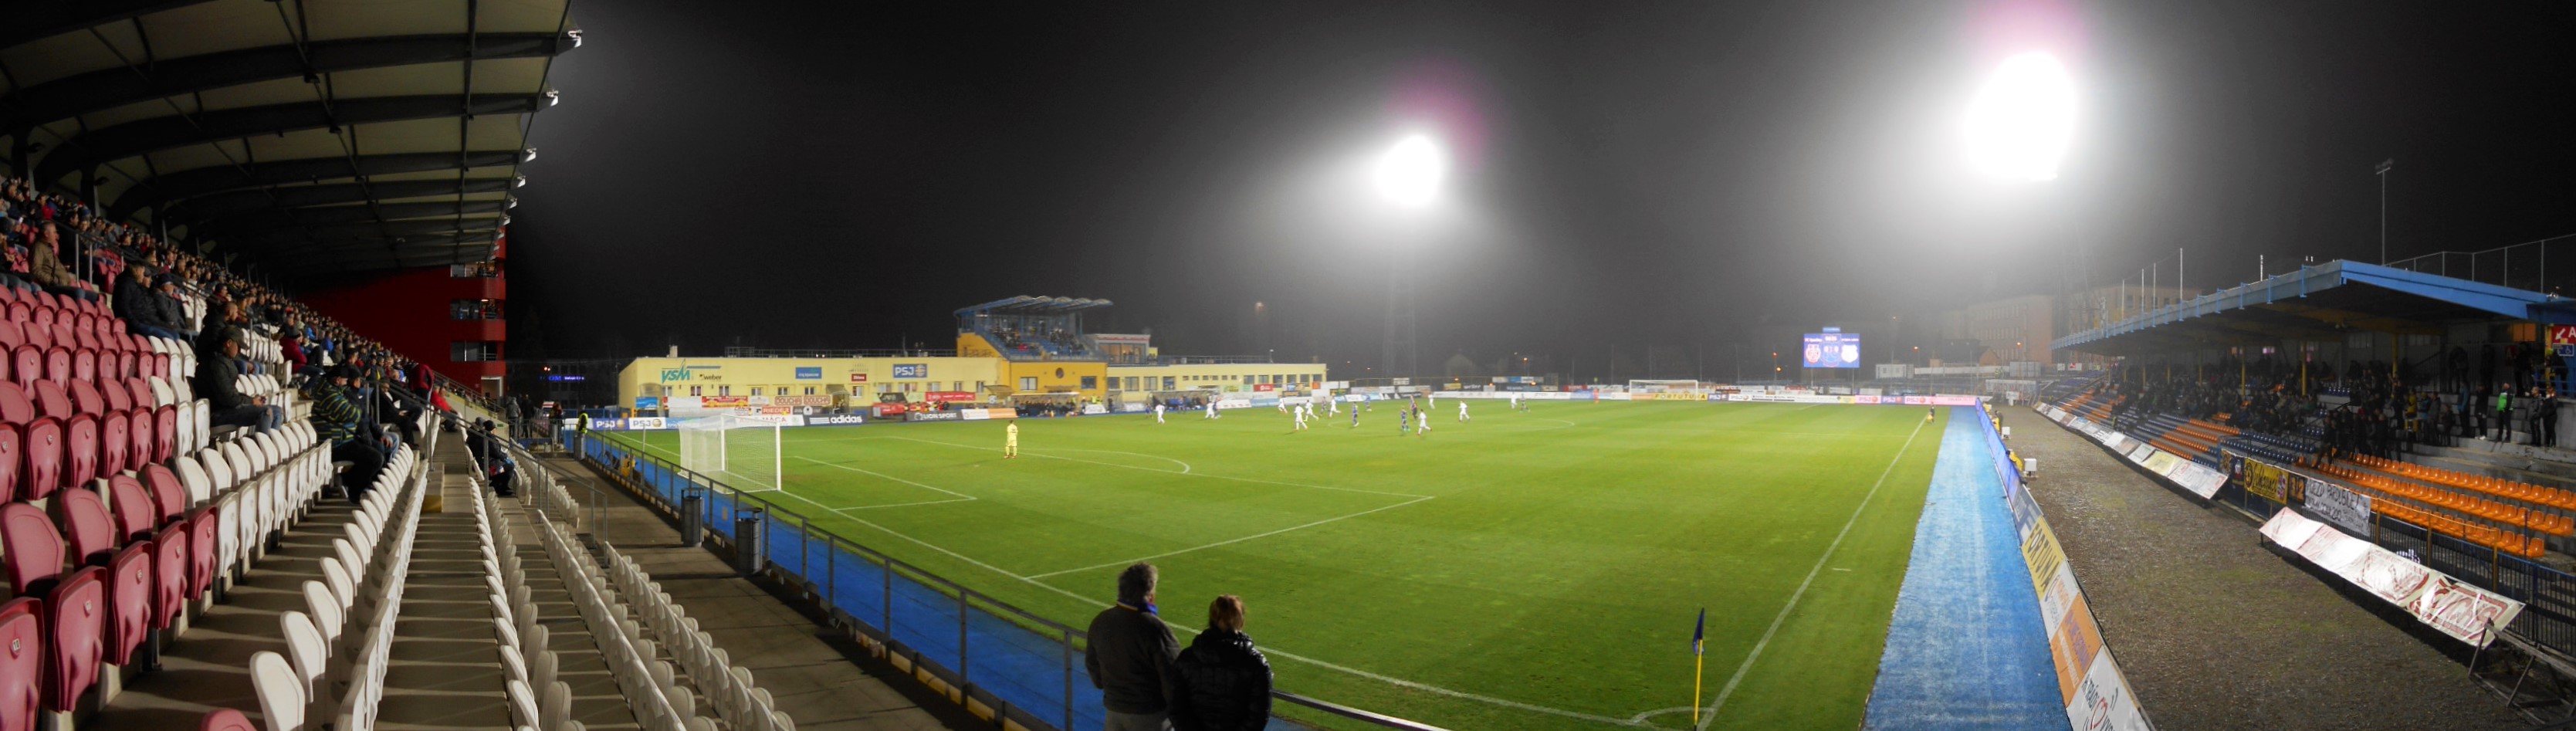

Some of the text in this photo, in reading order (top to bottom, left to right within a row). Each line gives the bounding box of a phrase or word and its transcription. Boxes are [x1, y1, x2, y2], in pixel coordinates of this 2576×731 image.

[895, 367, 914, 376] PSJ
[830, 415, 862, 424] adidas
[2025, 523, 2060, 593] FORTUNA
